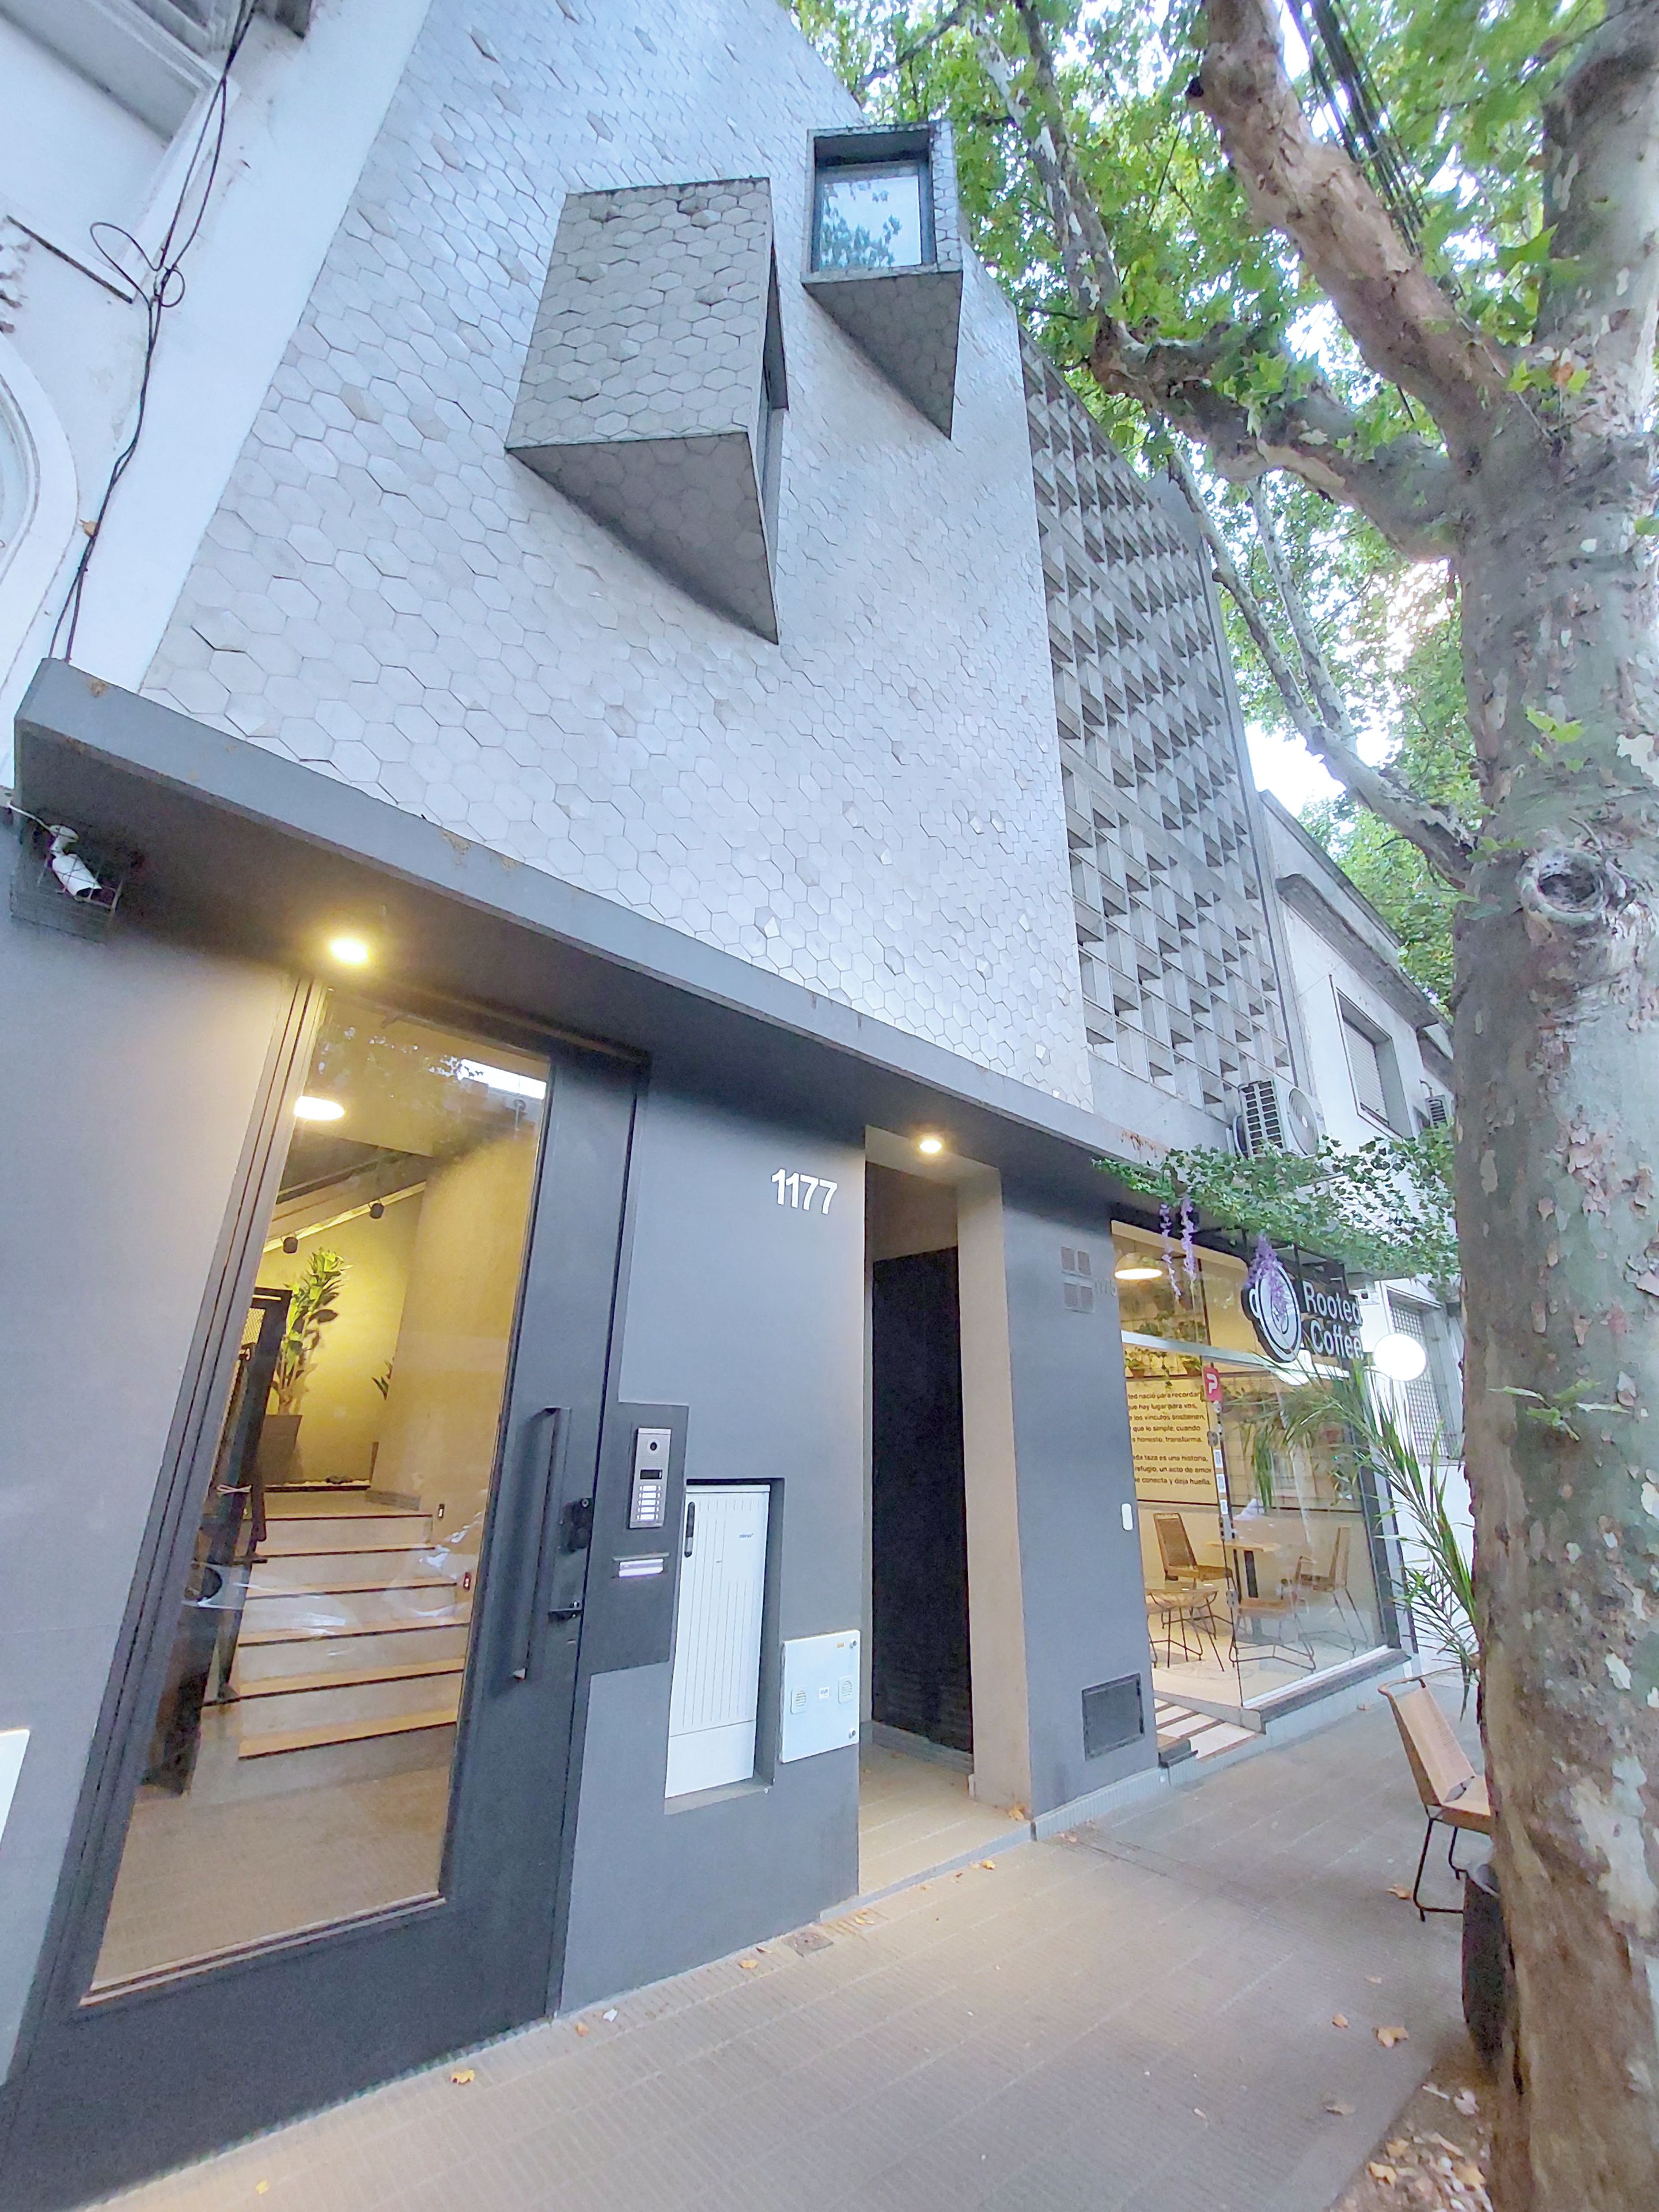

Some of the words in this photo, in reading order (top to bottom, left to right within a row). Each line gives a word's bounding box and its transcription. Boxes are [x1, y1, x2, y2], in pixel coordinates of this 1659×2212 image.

[771, 1168, 838, 1215] 1177
[1302, 1280, 1363, 1325] Rooted
[1310, 1320, 1364, 1360] Coffee
